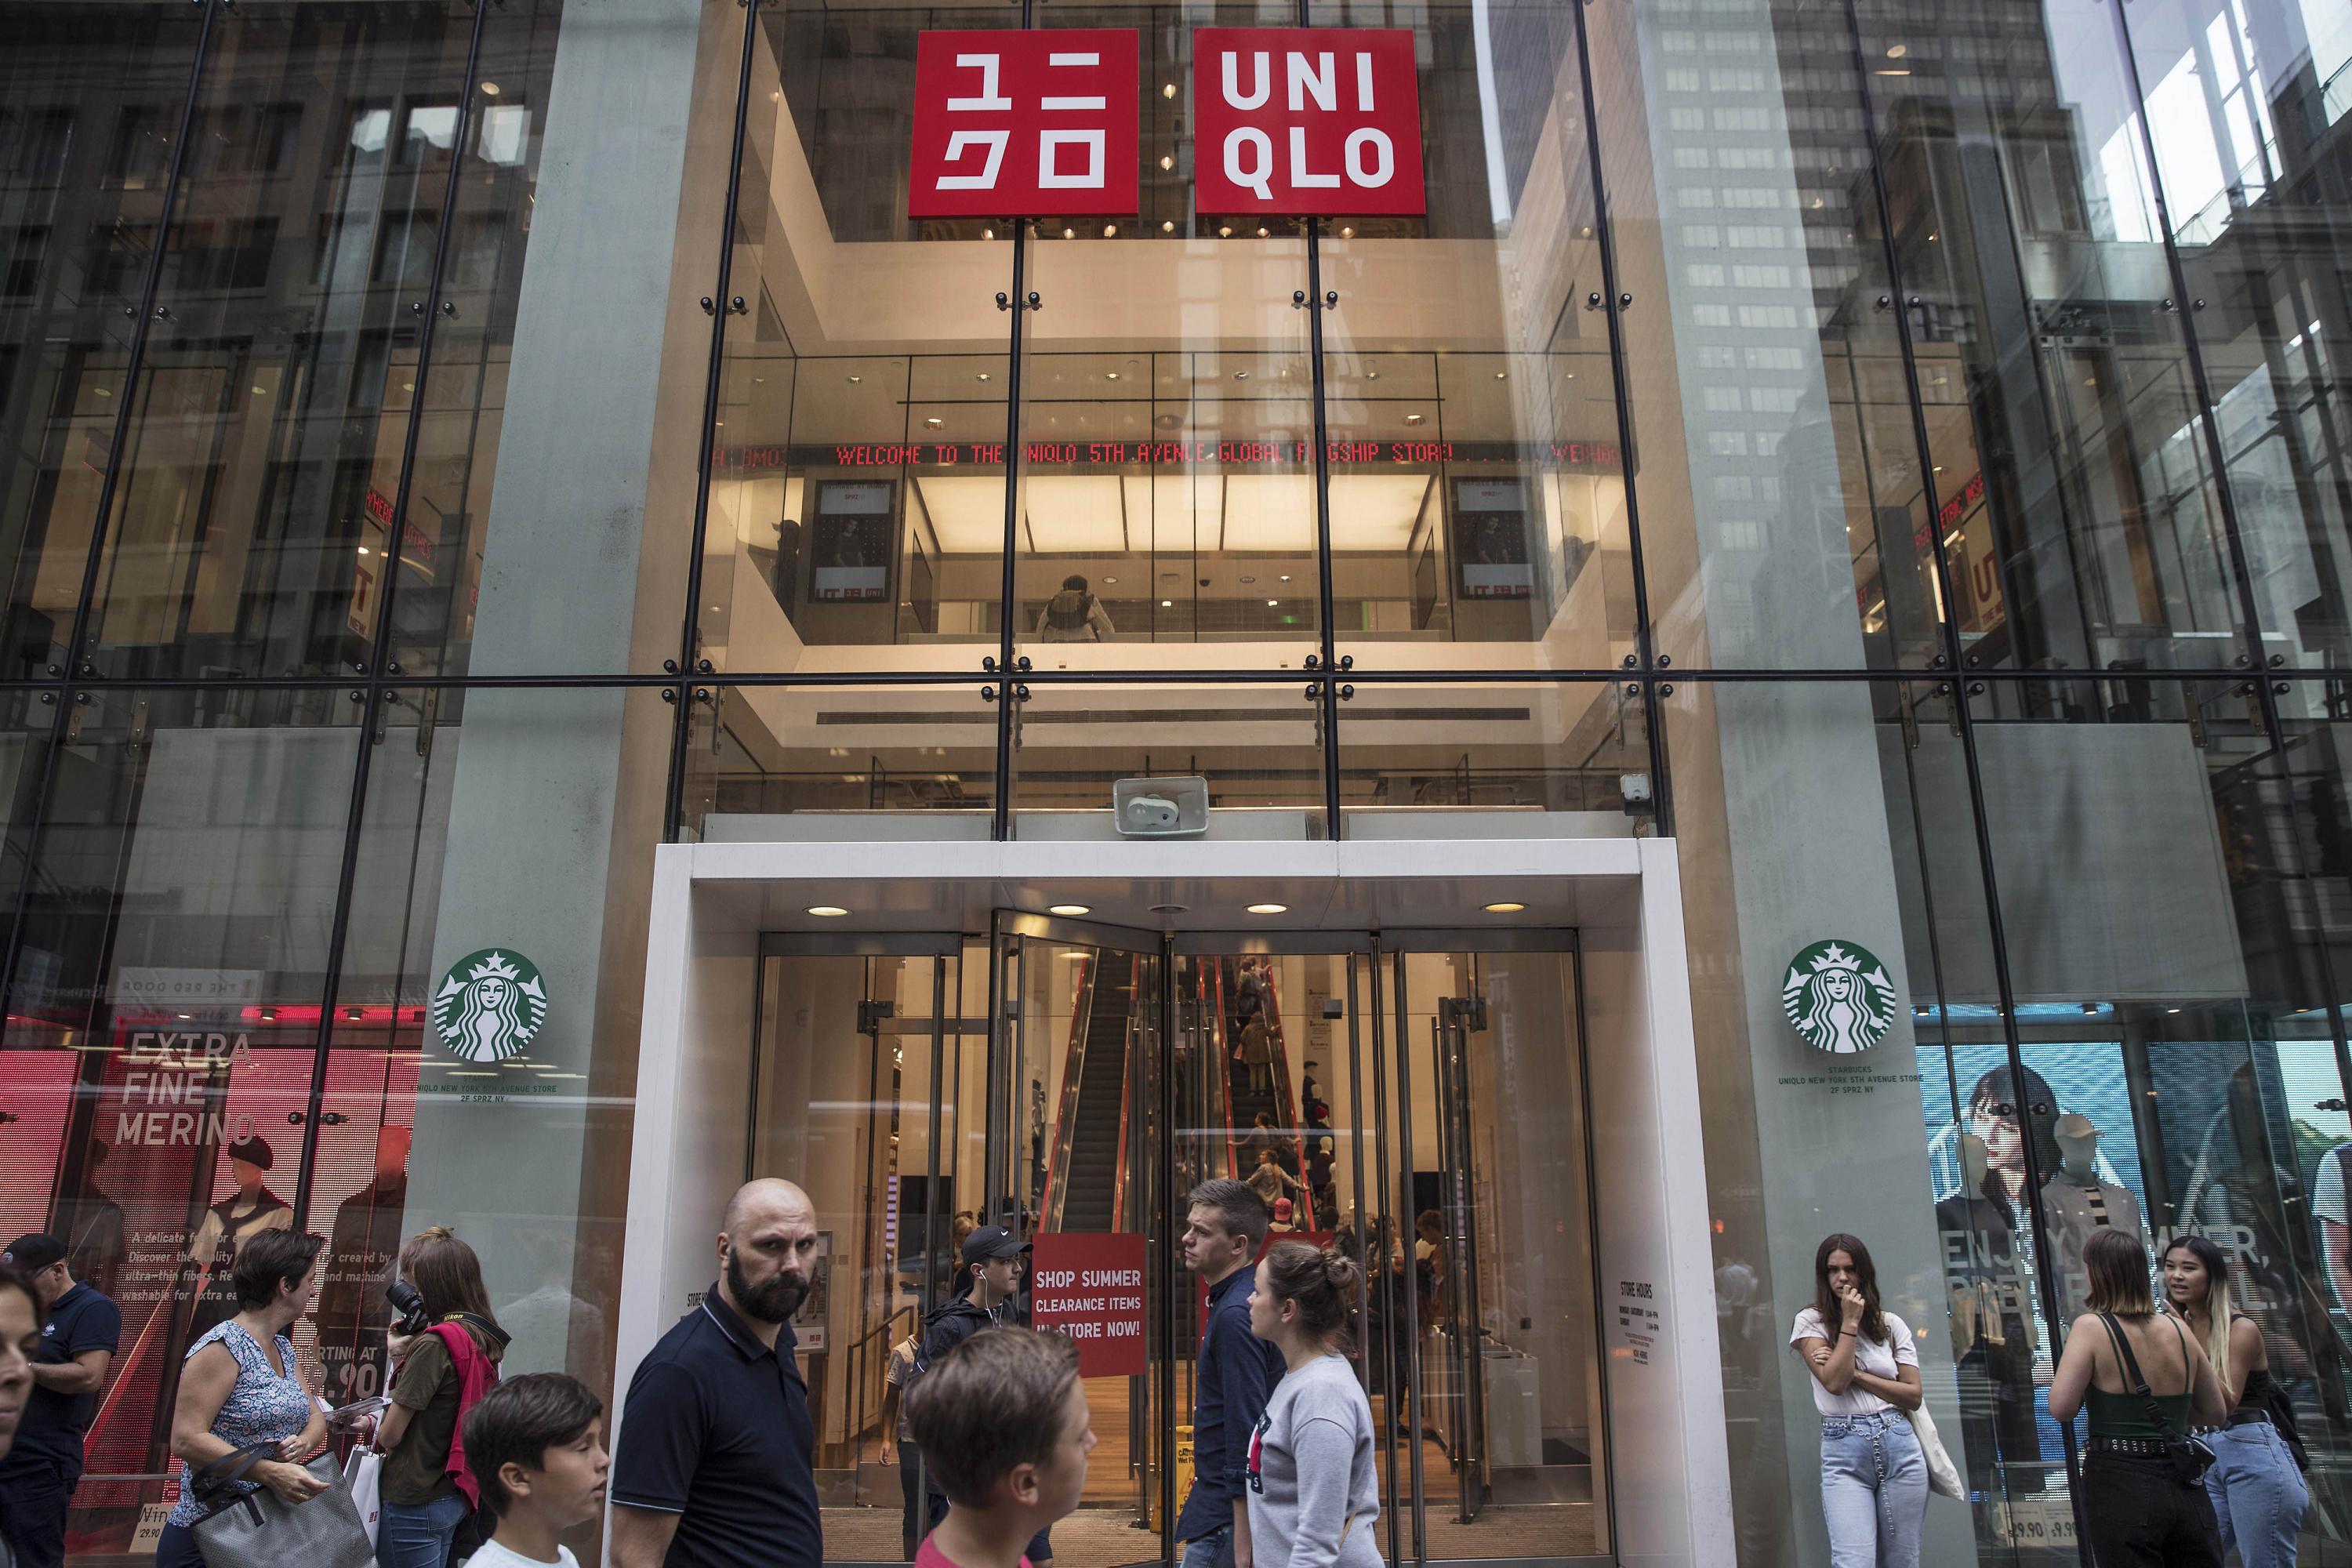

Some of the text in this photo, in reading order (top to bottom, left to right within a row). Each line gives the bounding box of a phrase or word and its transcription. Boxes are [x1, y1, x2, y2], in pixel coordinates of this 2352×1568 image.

[947, 53, 1106, 111] ユニ
[1221, 51, 1374, 111] UNI
[935, 129, 1105, 190] クロ
[1223, 126, 1395, 200] QLO
[837, 445, 922, 465] WELCOME
[935, 445, 957, 464] TO
[971, 445, 1004, 463] THE
[1022, 443, 1077, 463] NIQLO
[1090, 443, 1124, 463] 5TH
[1218, 442, 1284, 463] GLOBAL
[1298, 442, 1380, 463] FGSHIP
[1391, 443, 1453, 463] STORE!
[128, 1033, 251, 1065] EXTRA
[1900, 1074, 1925, 1083] STORE
[122, 1073, 210, 1105] FINE
[114, 1112, 255, 1146] MERINO
[132, 1232, 140, 1243] A
[145, 1232, 185, 1243] delicate
[128, 1251, 172, 1262] Discover
[177, 1250, 195, 1262] the
[379, 1252, 392, 1266] by
[125, 1269, 179, 1282] ultra-thin
[324, 1271, 343, 1282] and
[1036, 1269, 1142, 1288] SHOP SUMMER
[175, 1290, 191, 1301] for
[1620, 1281, 1653, 1299] STORE HOURS
[688, 1292, 702, 1307] STORE
[1036, 1297, 1142, 1312] CLEARANCE ITEMS
[444, 1313, 464, 1322] Nikon
[1107, 1321, 1140, 1338] NOW!
[359, 1346, 378, 1361] AT
